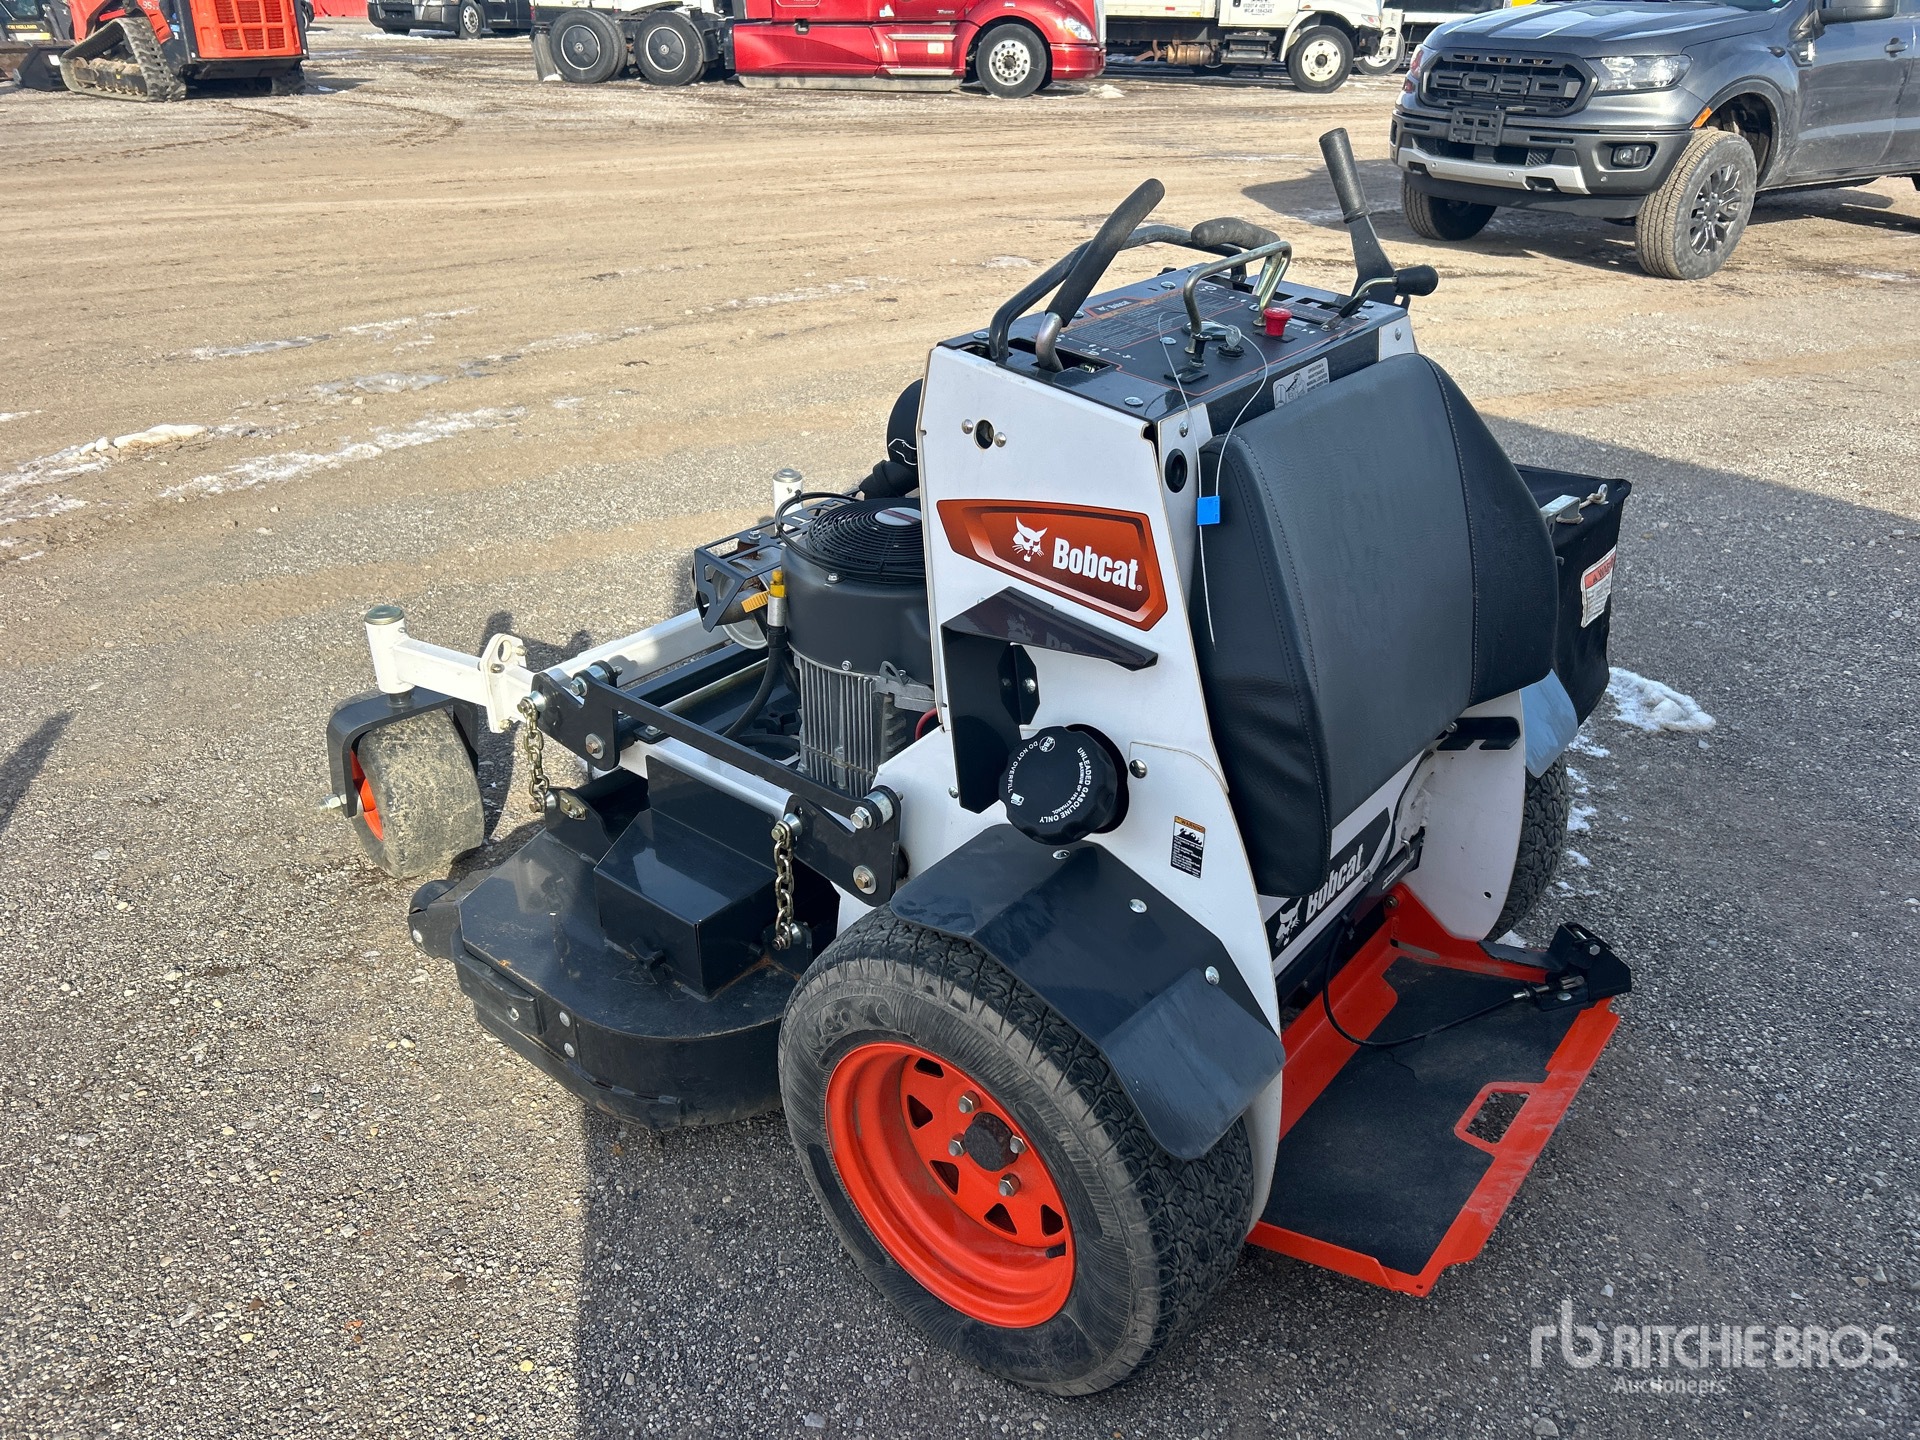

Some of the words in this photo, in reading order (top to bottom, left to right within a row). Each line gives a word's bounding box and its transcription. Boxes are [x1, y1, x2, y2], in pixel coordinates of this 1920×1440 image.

[1431, 71, 1569, 97] FORD
[1052, 537, 1139, 591] Bobcat
[1017, 748, 1028, 761] NOT
[1028, 741, 1038, 749] DO
[1008, 761, 1018, 793] OVERFILL
[1077, 747, 1092, 785] UNLEADED
[1061, 786, 1089, 819] GASOLINE
[1306, 843, 1364, 922] Bobcat
